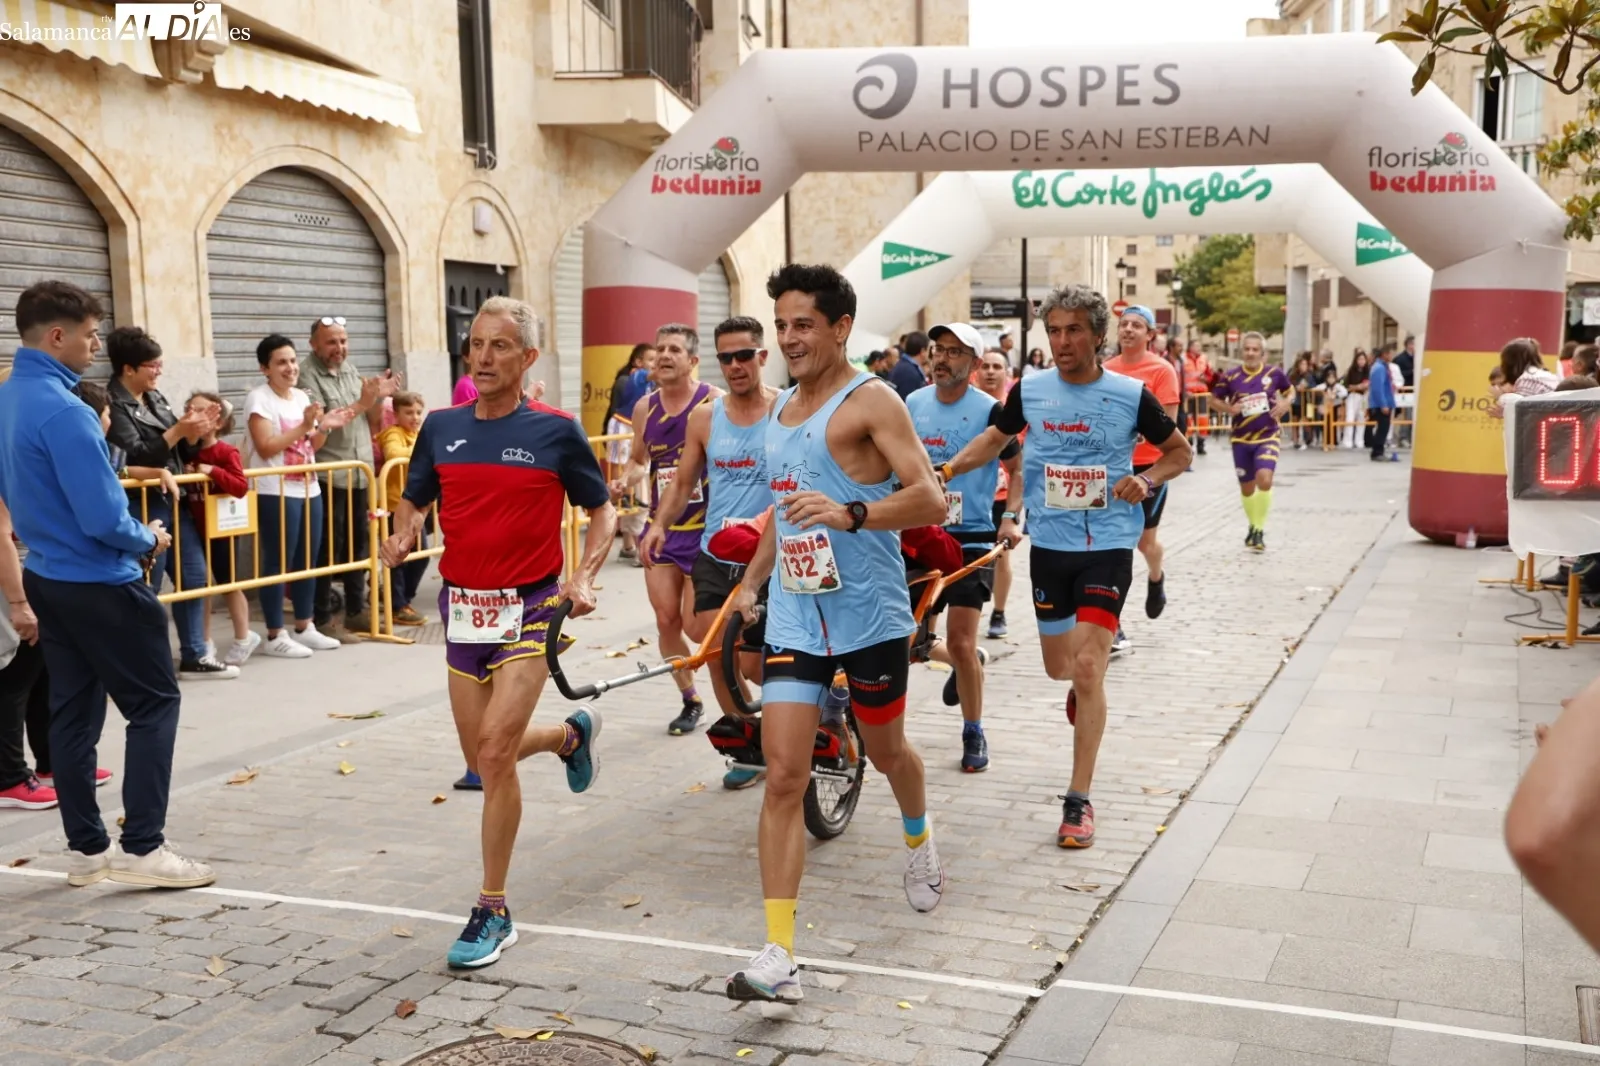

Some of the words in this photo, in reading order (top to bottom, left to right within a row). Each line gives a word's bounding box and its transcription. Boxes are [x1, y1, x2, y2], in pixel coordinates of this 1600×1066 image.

[941, 63, 1181, 109] HOSPES
[858, 128, 998, 153] PALACIO
[1010, 129, 1050, 151] DE
[1060, 128, 1123, 151] SAN
[1136, 124, 1270, 149] ESTEBAN
[651, 173, 762, 196] bedunia
[1369, 168, 1497, 193] bedunia
[1012, 169, 1048, 209] El
[1051, 171, 1136, 208] Corte
[1142, 166, 1272, 219] Inglés
[1046, 466, 1106, 481] bedunia
[1063, 481, 1087, 498] 73
[783, 555, 819, 578] 132
[451, 590, 522, 608] bedunia
[471, 608, 500, 628] 82
